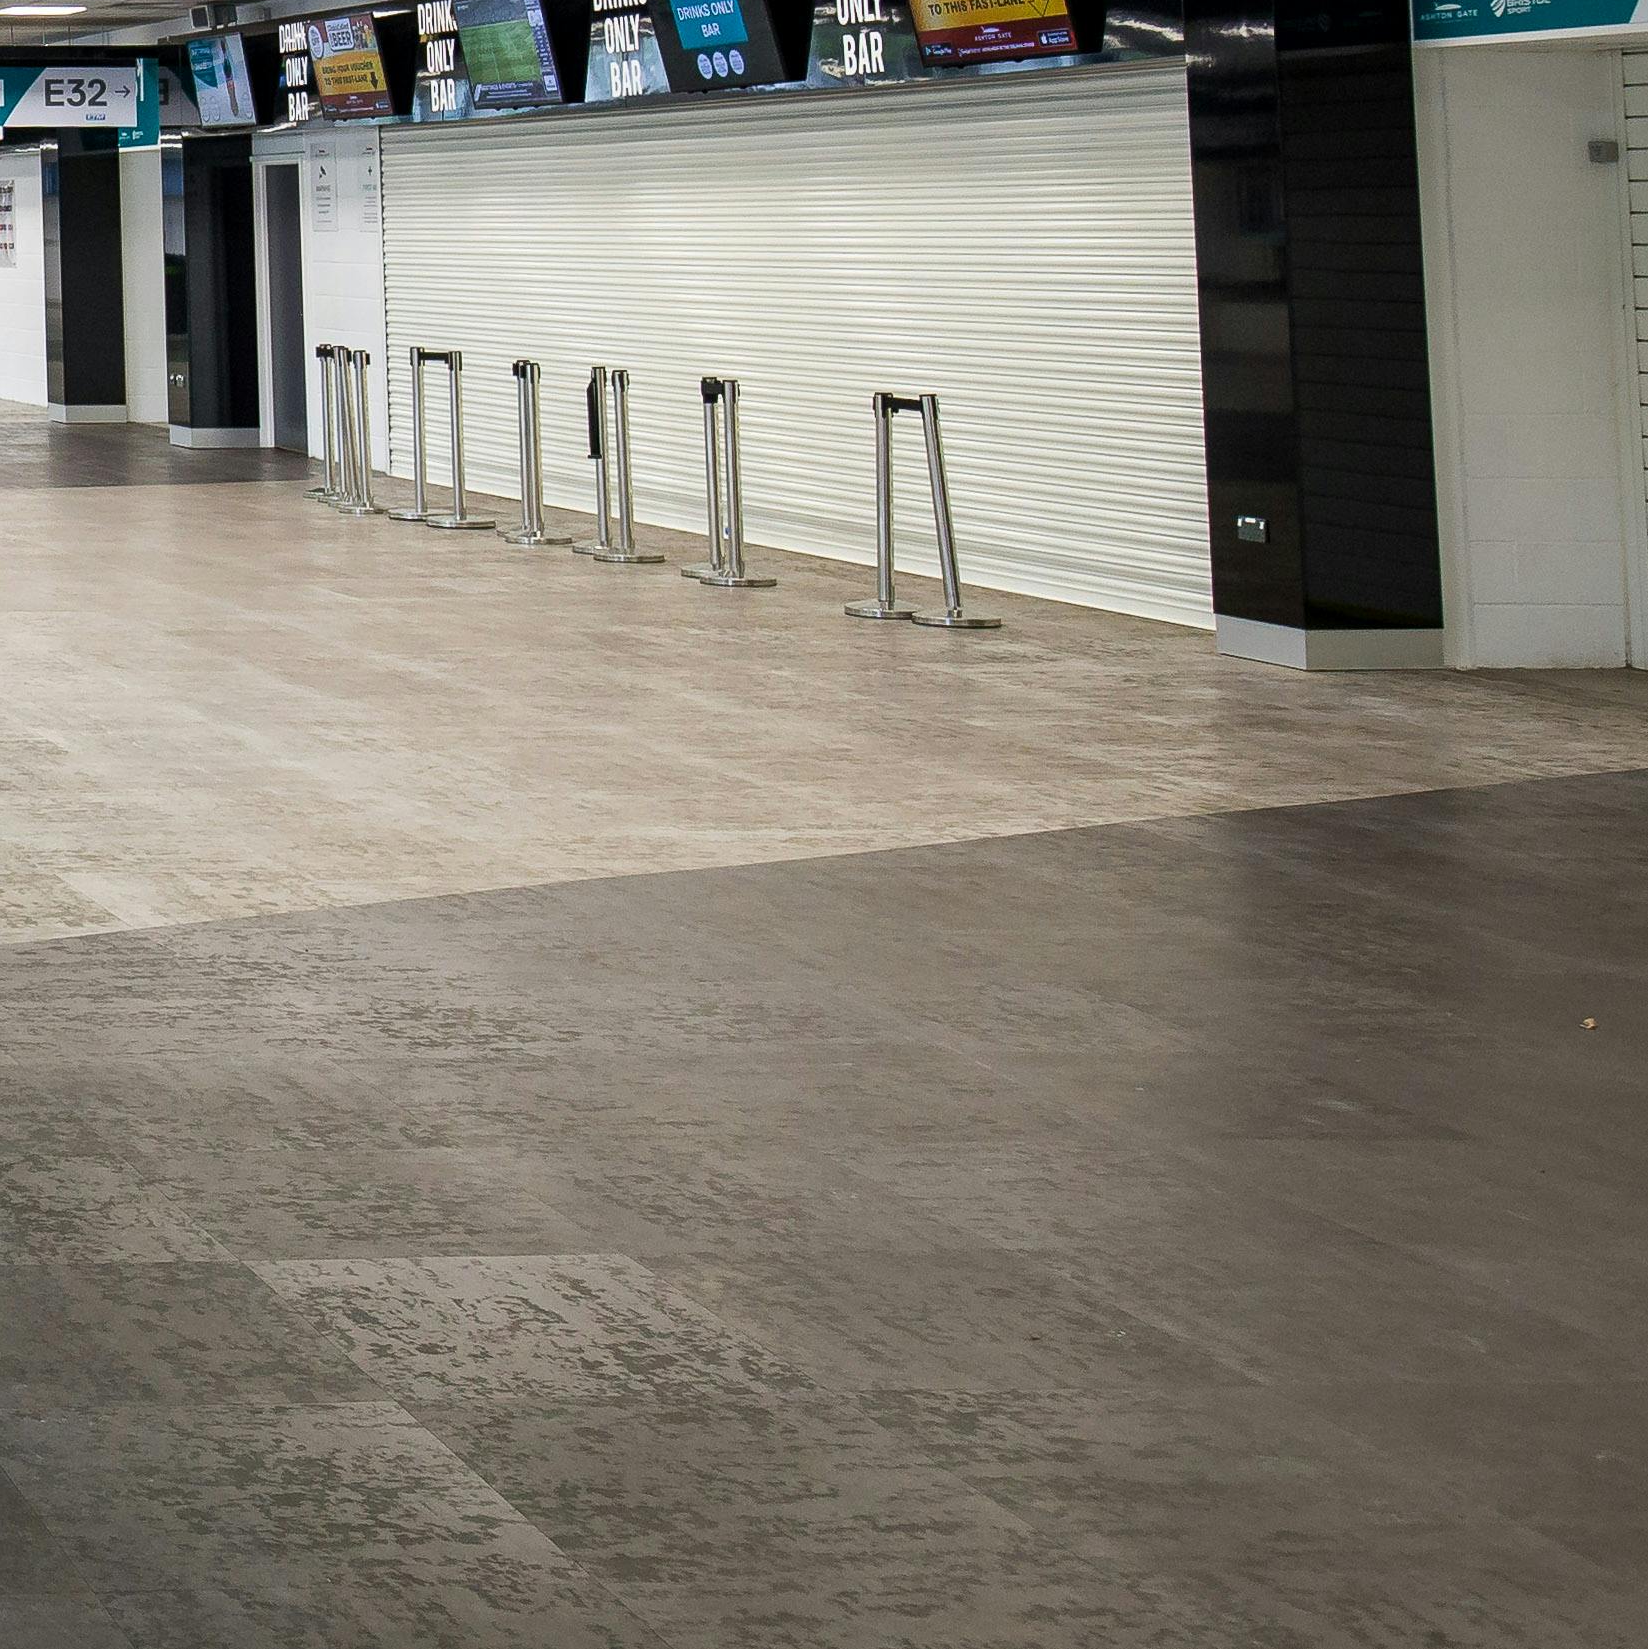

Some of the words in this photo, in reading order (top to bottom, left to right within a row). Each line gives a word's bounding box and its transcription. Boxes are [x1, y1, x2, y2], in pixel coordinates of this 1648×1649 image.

[677, 4, 710, 22] DRINKS
[711, 0, 734, 16] ONLY
[928, 4, 942, 16] TO
[944, 0, 967, 14] THIS
[1421, 12, 1452, 21] ASHTON
[1457, 10, 1478, 18] GATE
[1507, 6, 1531, 14] SPORT
[279, 21, 307, 54] DRINK
[332, 30, 352, 47] BEER
[604, 14, 640, 54] ONLY
[702, 24, 721, 38] BAR
[427, 38, 455, 73] ONLY
[843, 31, 885, 76] BAR
[286, 56, 308, 87] ONLY
[610, 60, 643, 98] BAR
[45, 79, 107, 107] E32
[288, 92, 309, 122] BAR
[431, 78, 457, 112] BAR
